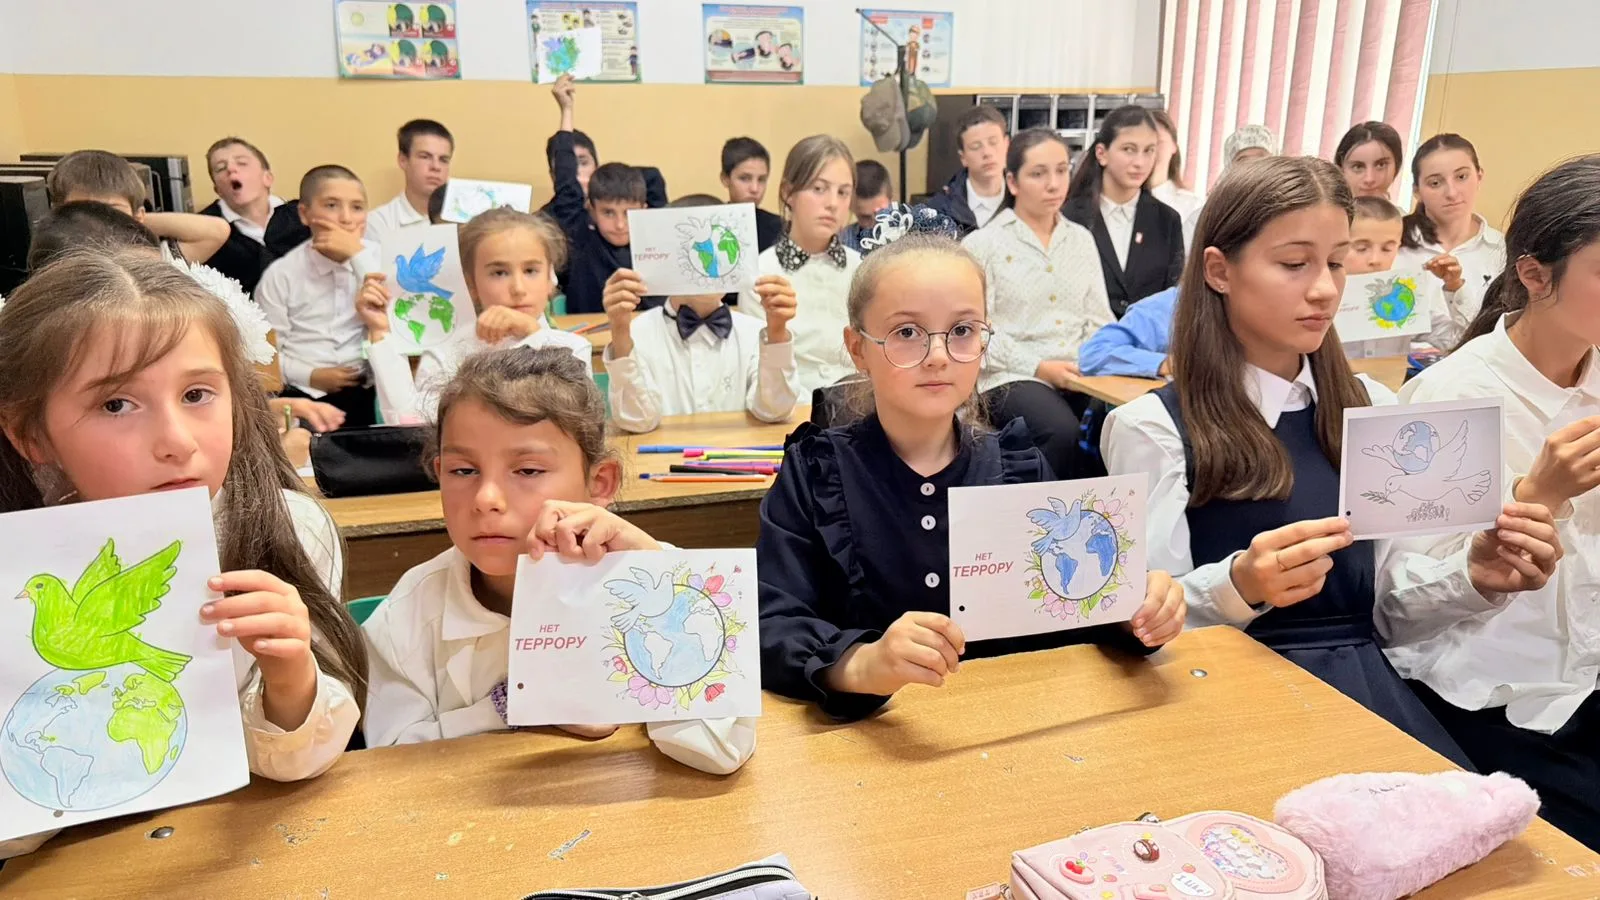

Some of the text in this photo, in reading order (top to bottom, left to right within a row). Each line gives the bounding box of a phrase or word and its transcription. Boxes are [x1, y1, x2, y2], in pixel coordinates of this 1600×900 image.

[974, 552, 993, 561] НЕТ
[953, 561, 1014, 577] ТЕРРОРУ
[539, 624, 560, 633] НЕТ
[515, 636, 587, 651] ТЕРРОРУ
